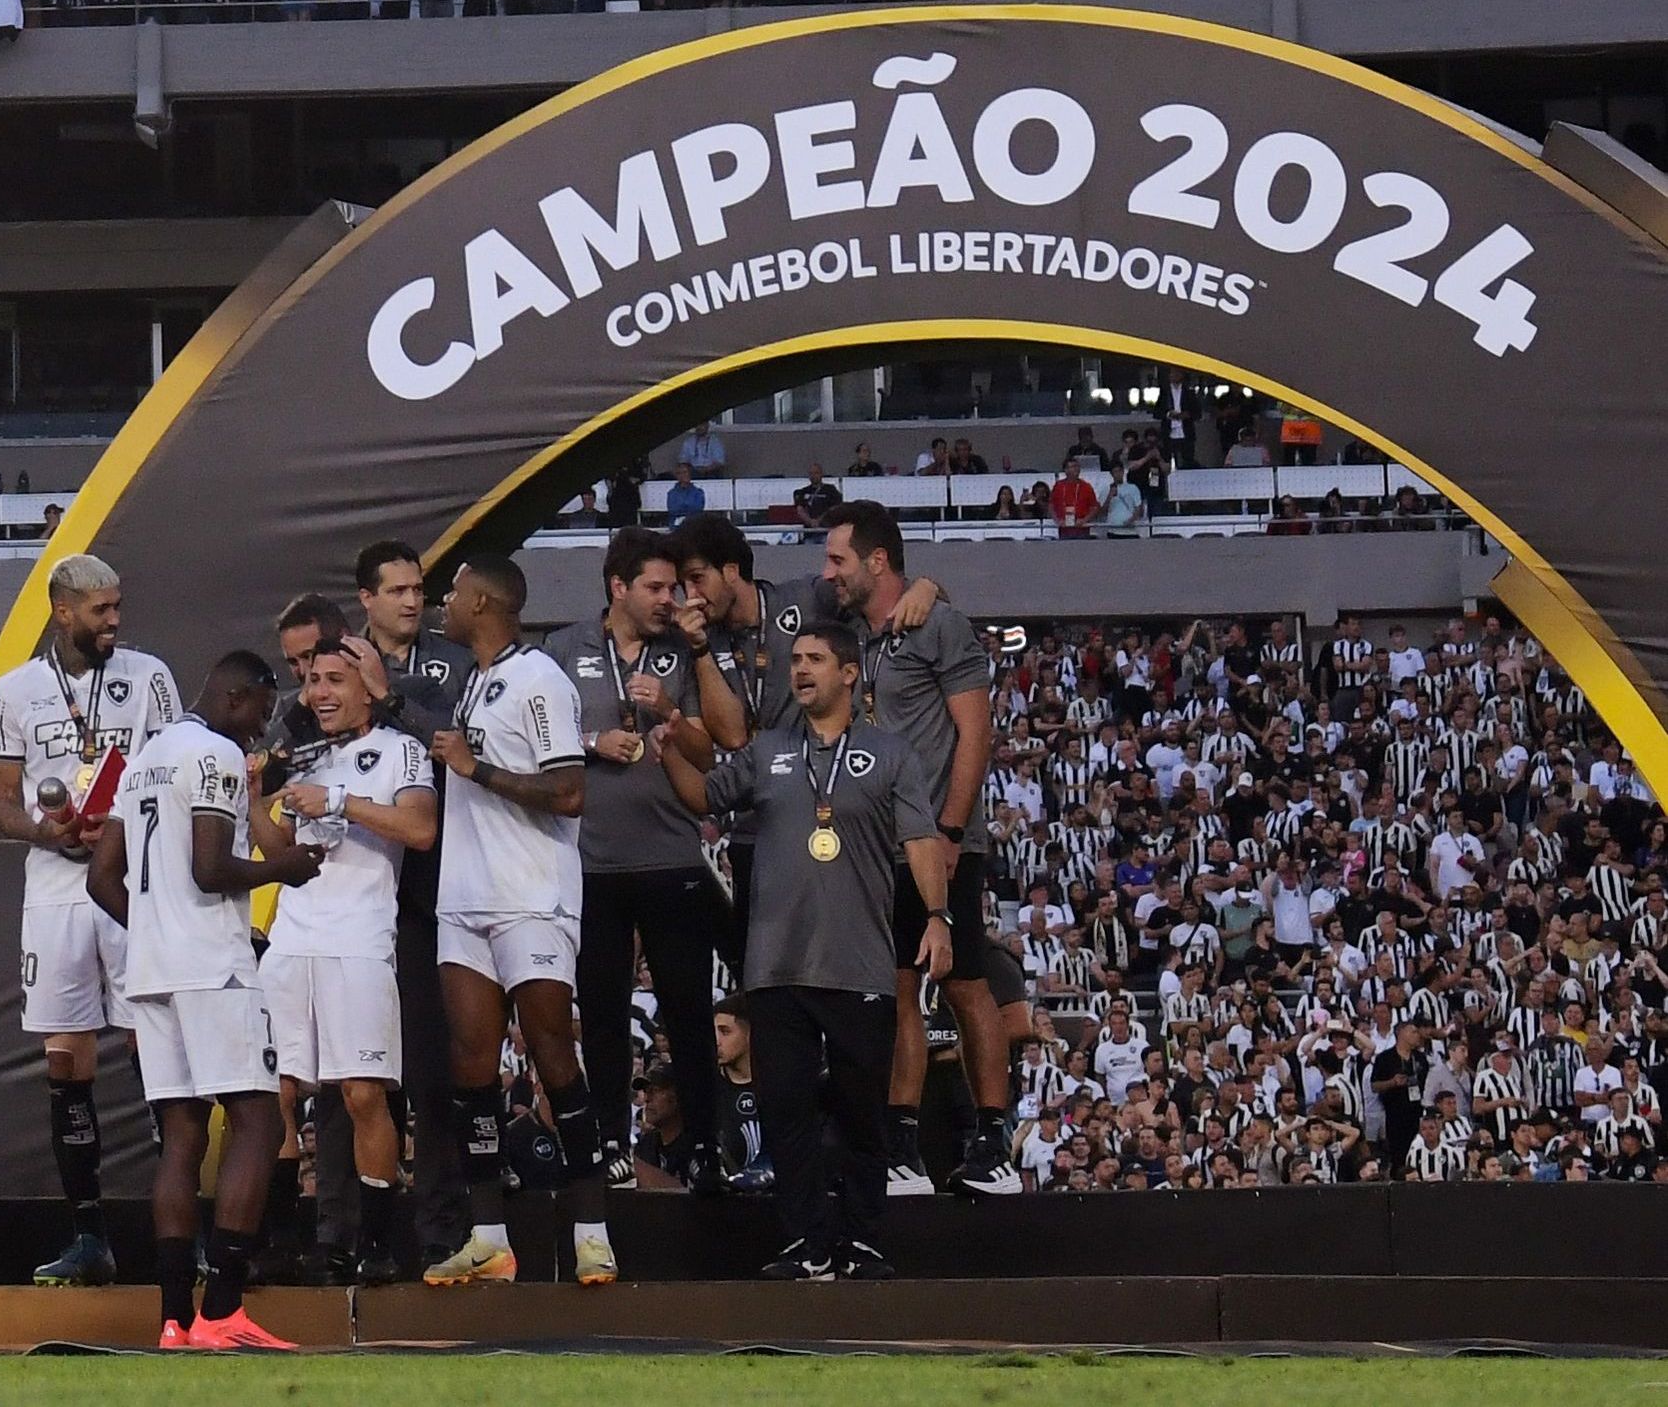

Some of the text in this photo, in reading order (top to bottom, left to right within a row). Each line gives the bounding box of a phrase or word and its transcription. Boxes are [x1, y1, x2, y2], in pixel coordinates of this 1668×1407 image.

[366, 51, 1539, 401] CAMPEÃO 2024
[605, 230, 1256, 349] CONMEBOL LIBERTADORES
[153, 671, 173, 724] Centrum
[535, 695, 552, 753] Centrum
[46, 728, 132, 759] MTCH
[140, 797, 160, 896] 7
[927, 1029, 958, 1041] ORES
